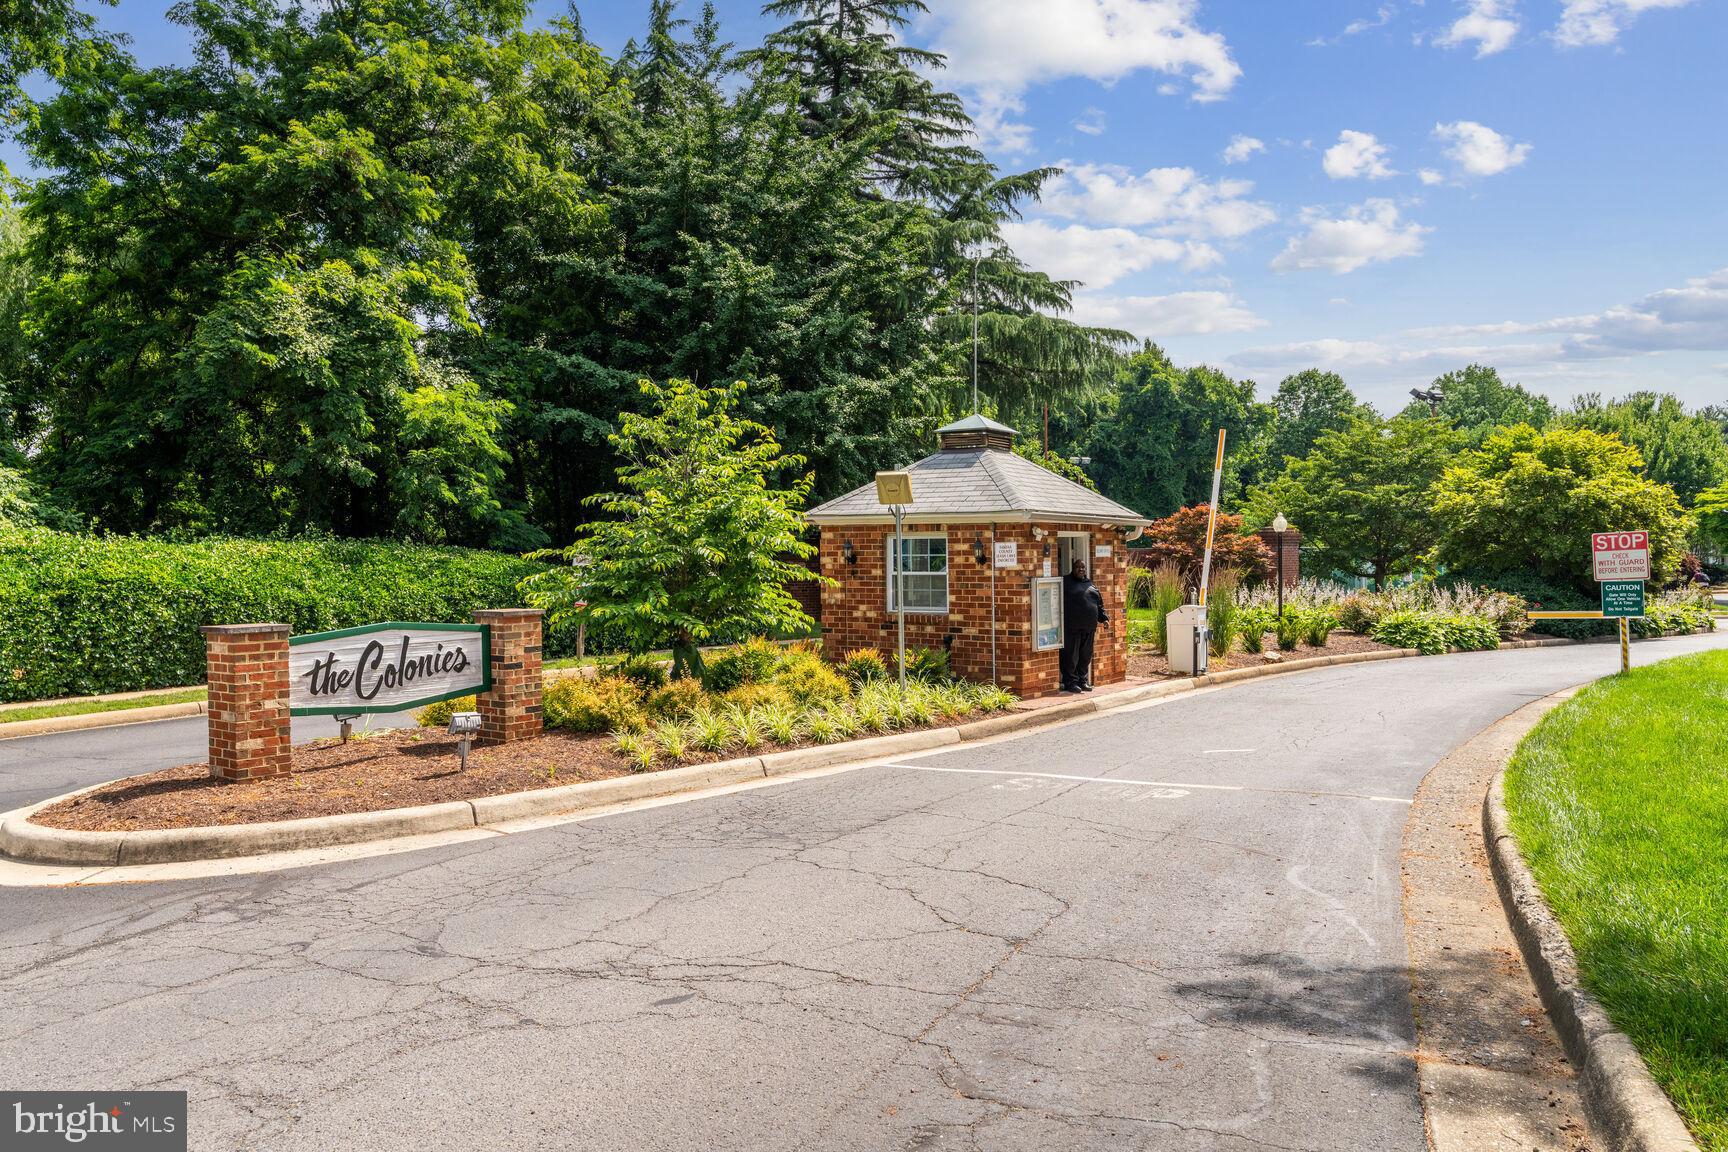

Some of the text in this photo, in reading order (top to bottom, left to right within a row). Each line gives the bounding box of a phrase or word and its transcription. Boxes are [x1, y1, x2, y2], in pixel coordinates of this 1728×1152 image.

[1596, 534, 1644, 550] STOP
[302, 635, 471, 700] the Colonies
